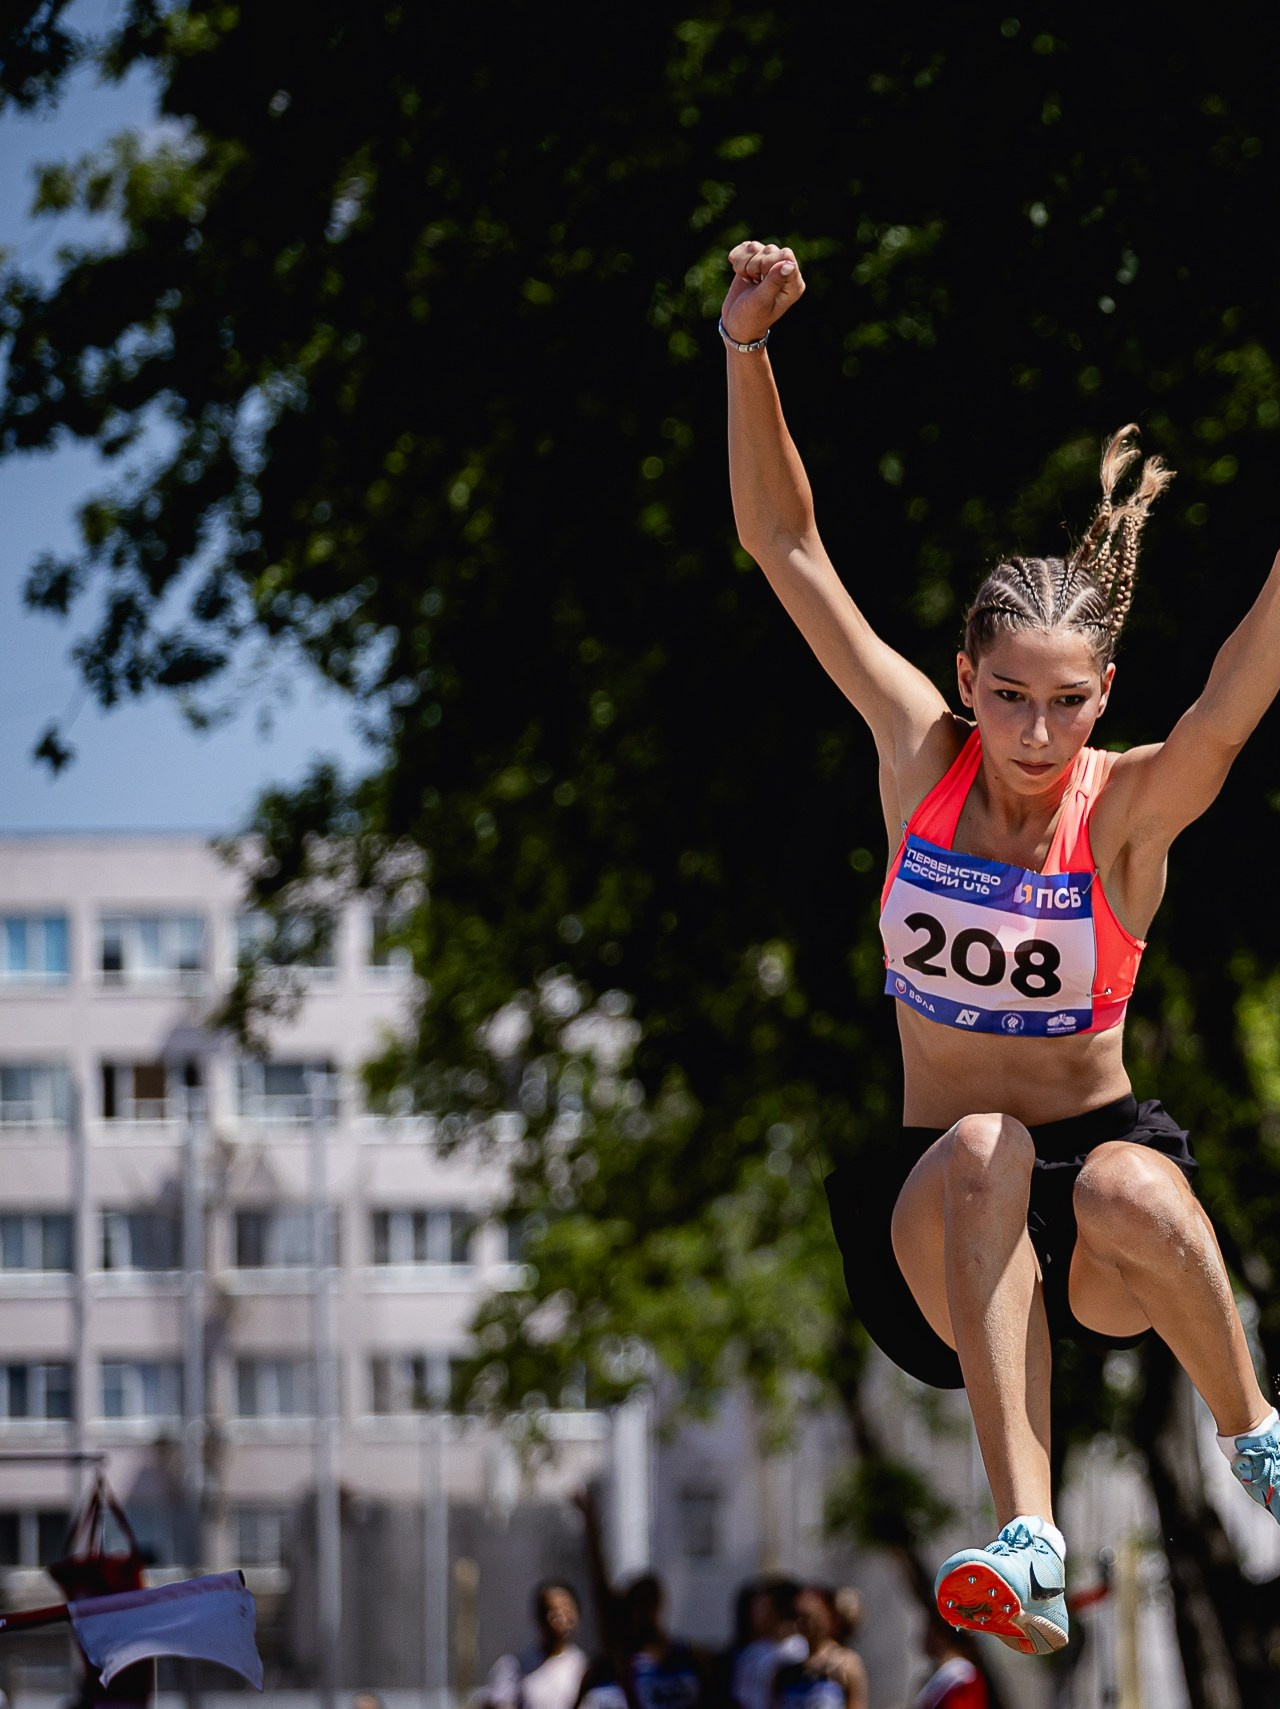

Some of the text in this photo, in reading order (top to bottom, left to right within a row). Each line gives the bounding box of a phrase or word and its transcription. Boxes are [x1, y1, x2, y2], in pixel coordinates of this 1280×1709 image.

[903, 859, 990, 896] РОССИИ U16
[906, 848, 1001, 886] ПЕРВЕНСТВО
[1035, 886, 1082, 909] ПСБ
[903, 912, 1062, 998] 208
[908, 989, 935, 1013] ВФЛА
